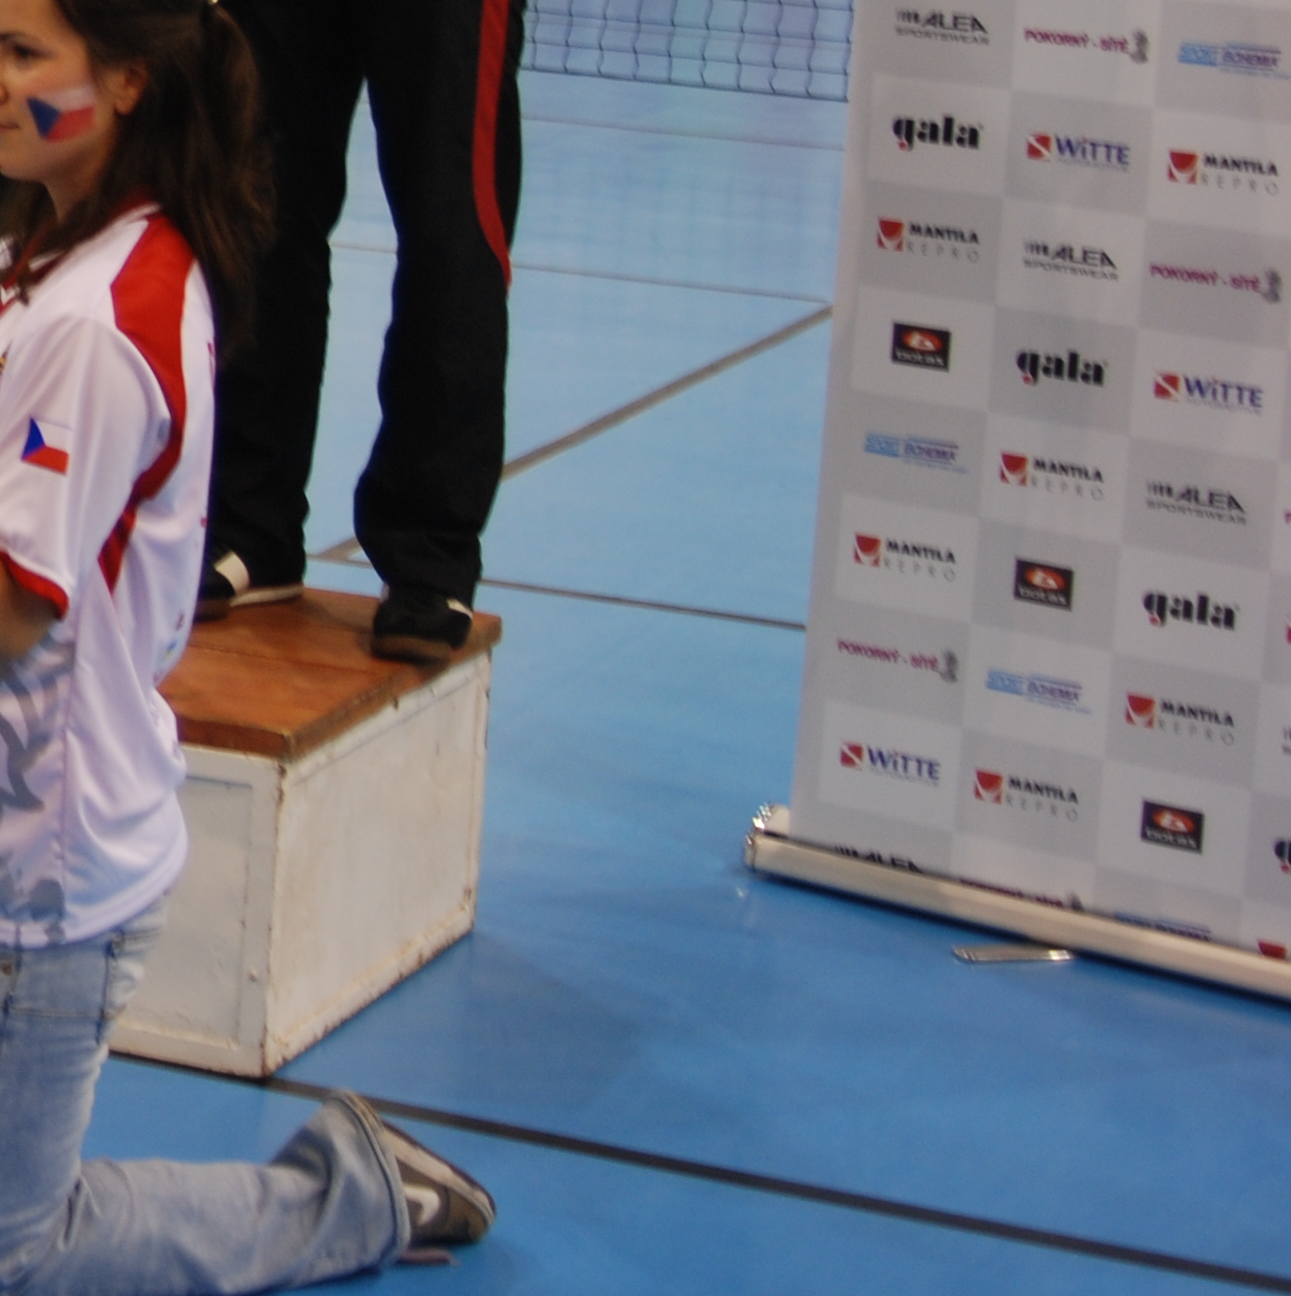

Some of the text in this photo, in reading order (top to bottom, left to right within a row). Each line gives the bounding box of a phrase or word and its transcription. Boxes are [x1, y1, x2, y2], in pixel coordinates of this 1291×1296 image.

[892, 113, 981, 152] gala
[1203, 154, 1279, 177] MANTILA
[909, 222, 980, 245] MANTILA
[1016, 349, 1105, 387] gala
[1033, 458, 1104, 483] MANTILA
[886, 538, 956, 565] MANTILA
[1142, 590, 1236, 631] gala
[1161, 701, 1234, 728] MANTILA
[1008, 774, 1078, 805] MANTILA
